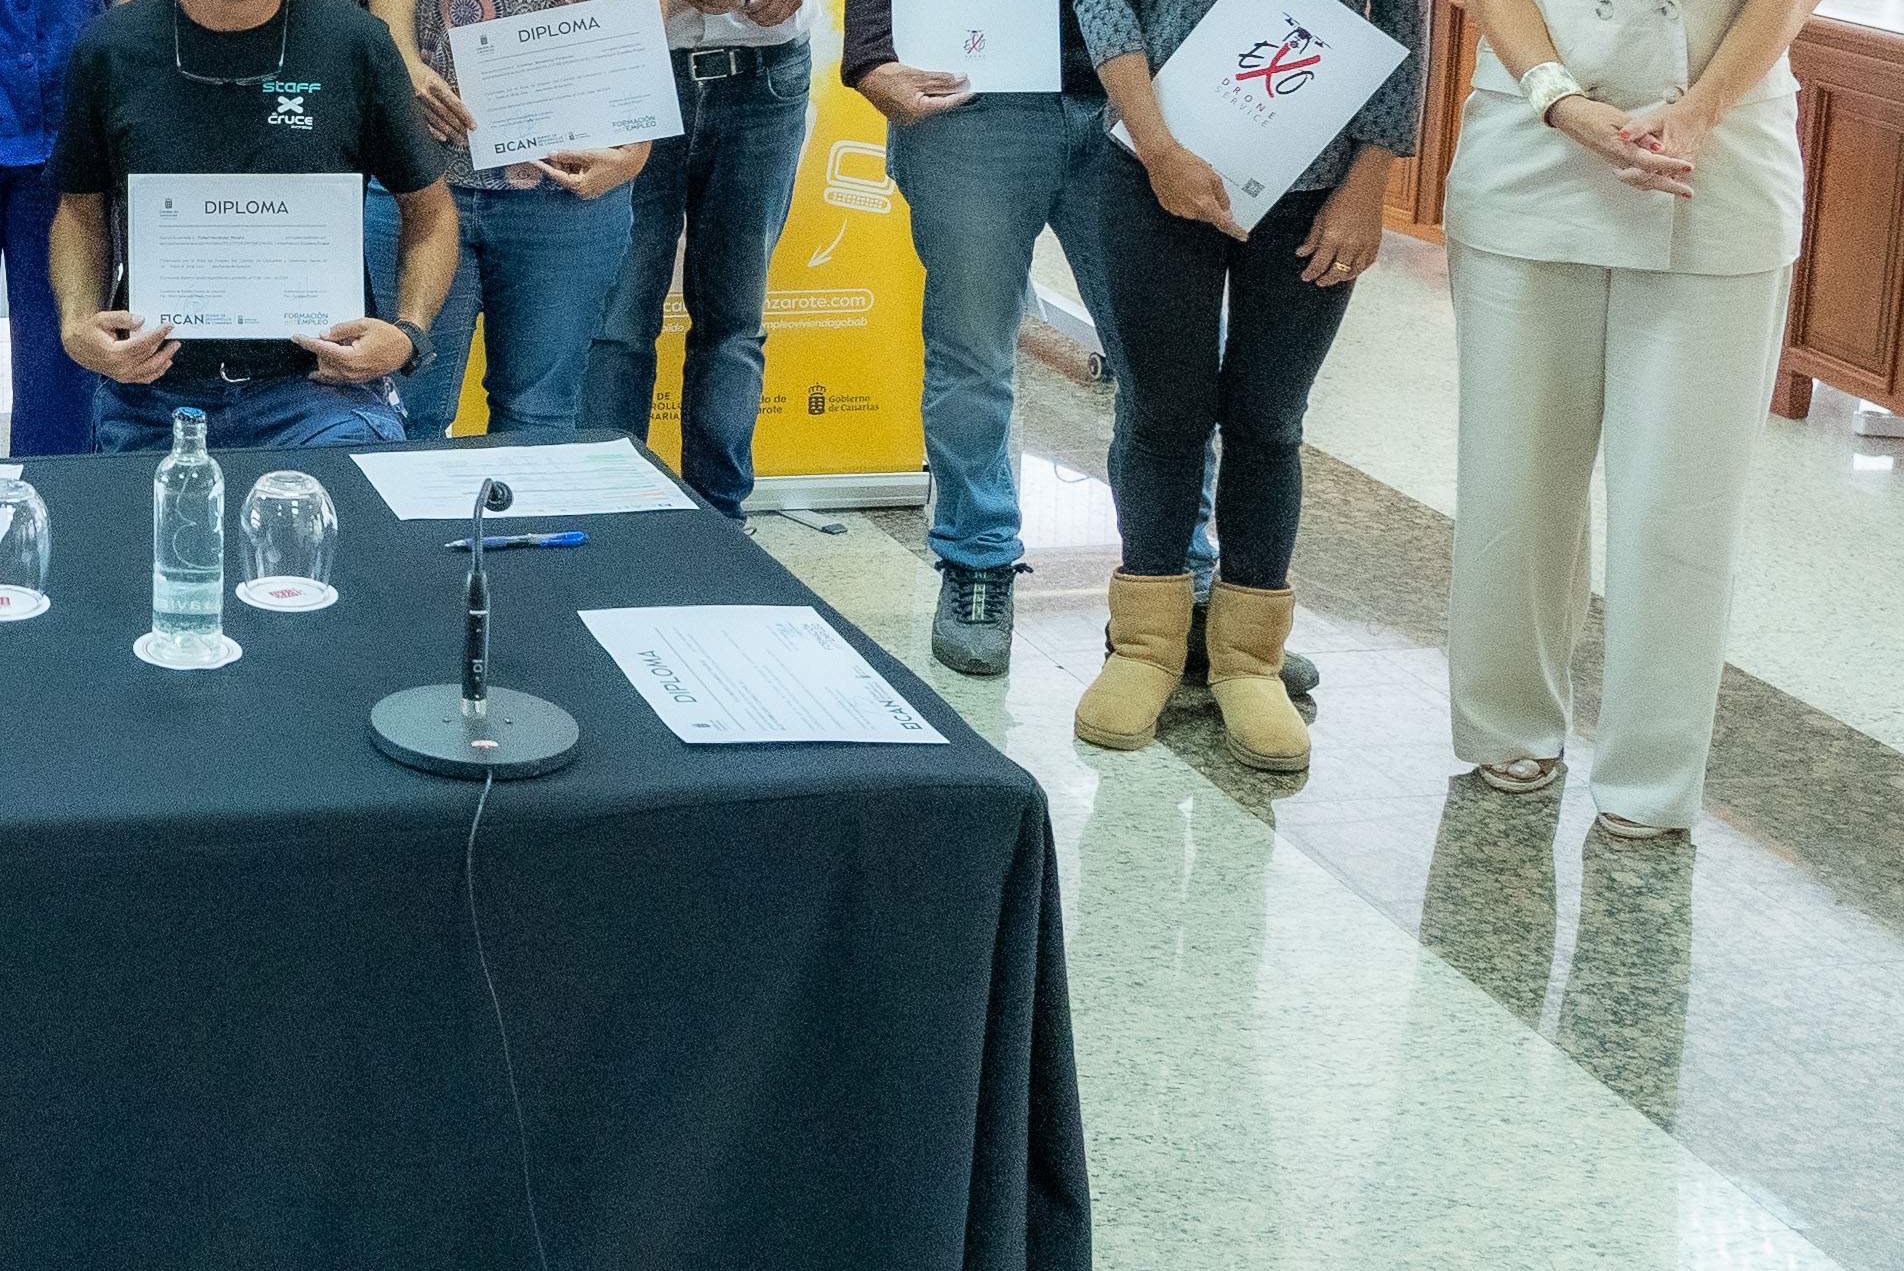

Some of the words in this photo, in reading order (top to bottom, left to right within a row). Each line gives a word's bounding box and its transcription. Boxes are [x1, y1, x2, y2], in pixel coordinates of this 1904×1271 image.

[518, 16, 601, 43] DIPLOMA
[1235, 40, 1321, 98] EXO
[1215, 85, 1270, 128] SERVICE
[1221, 78, 1277, 119] DRONE
[204, 200, 289, 214] DIPLOMA
[828, 394, 870, 403] Gobierno
[637, 650, 697, 704] DIPLOMA
